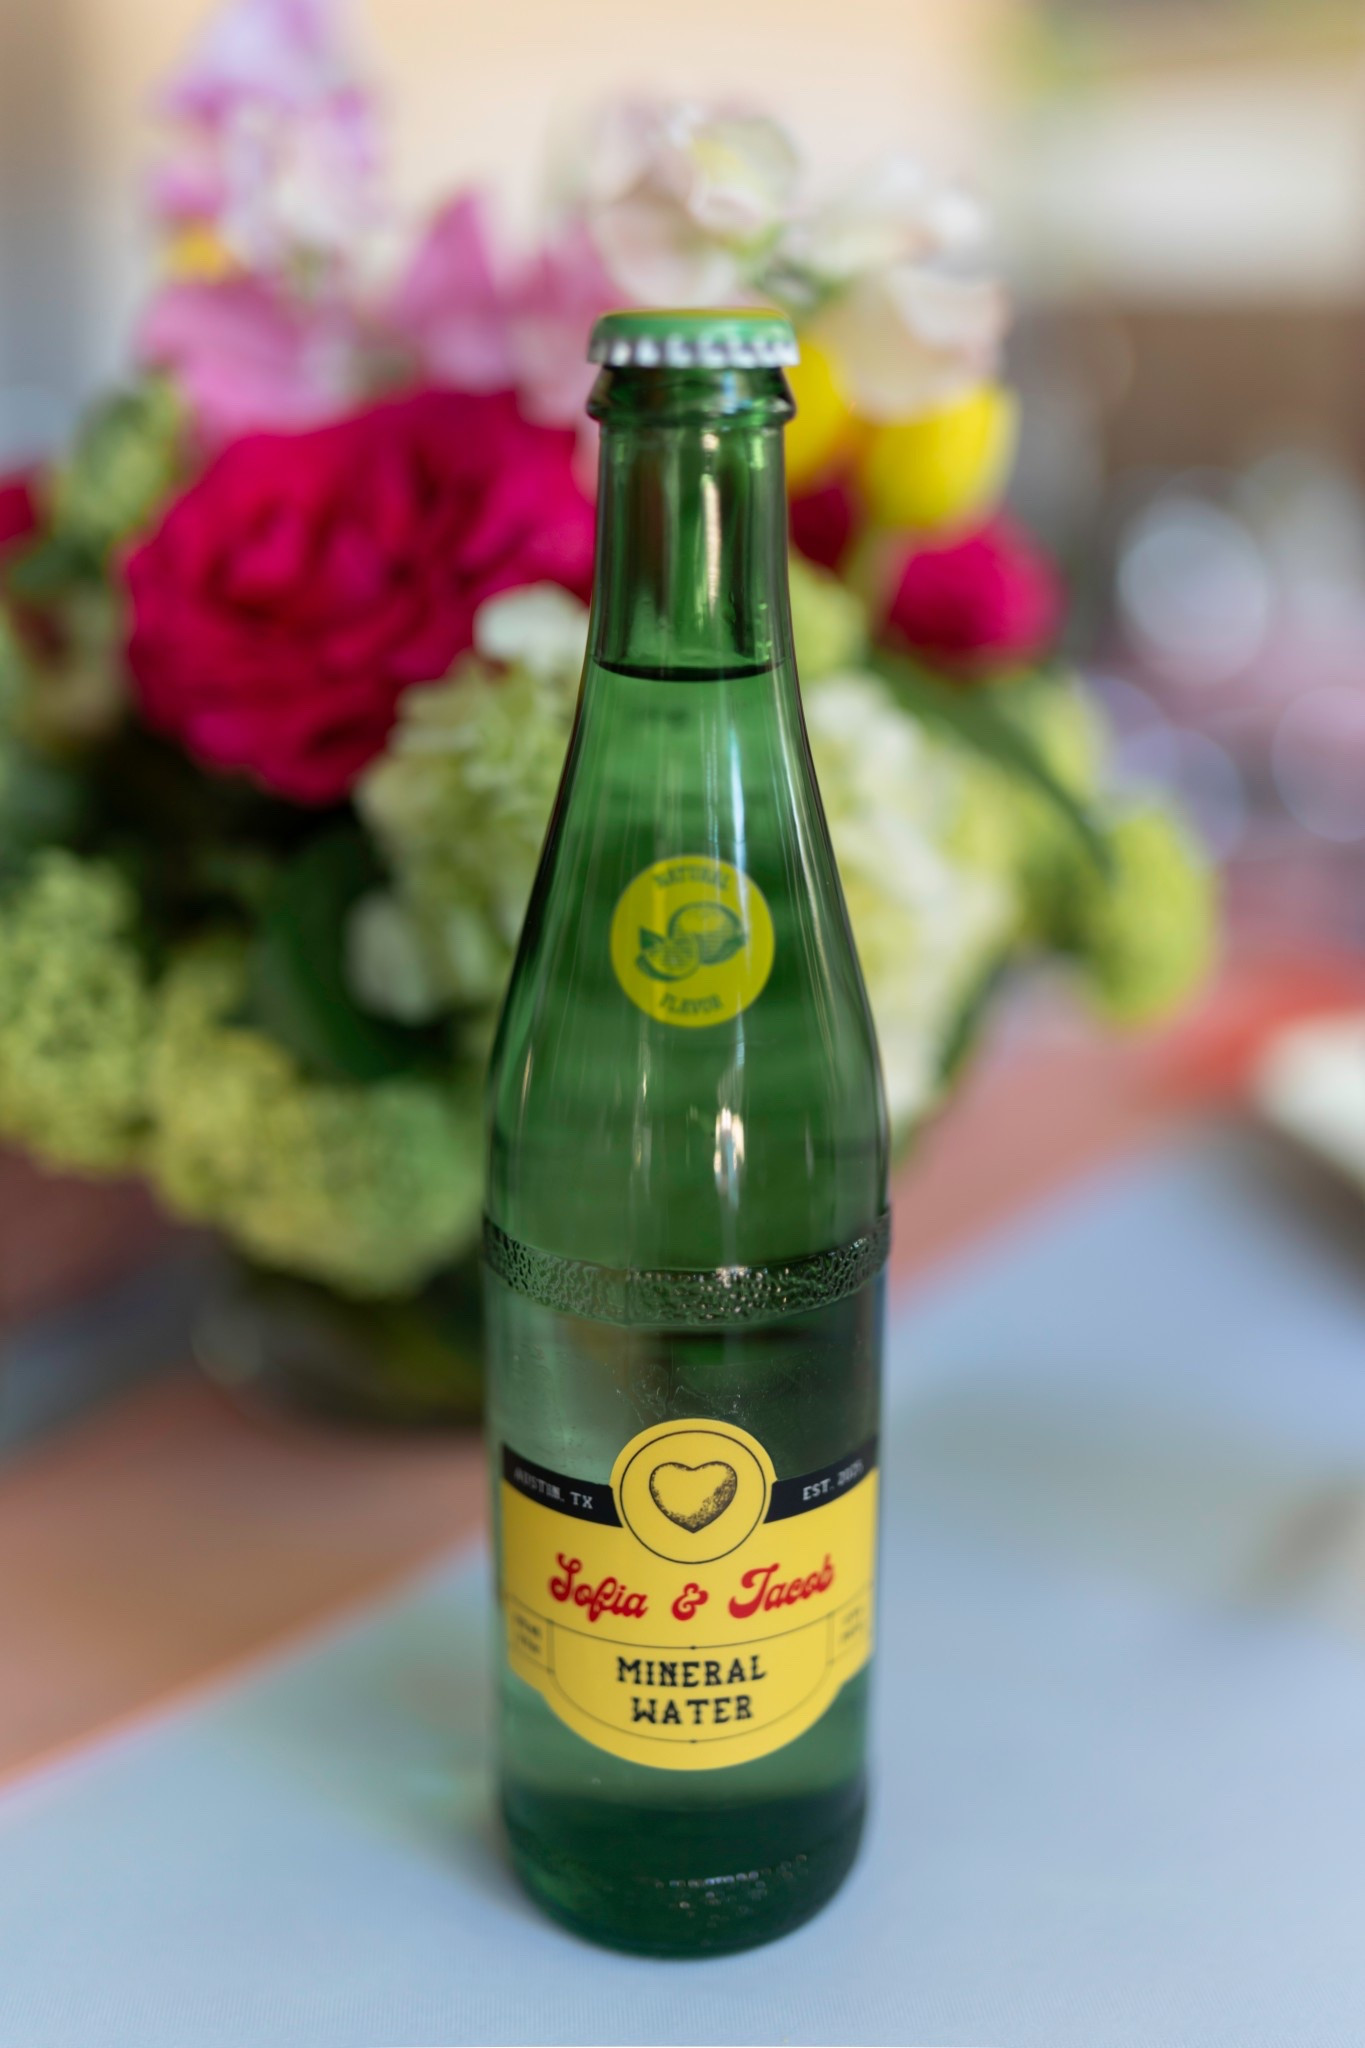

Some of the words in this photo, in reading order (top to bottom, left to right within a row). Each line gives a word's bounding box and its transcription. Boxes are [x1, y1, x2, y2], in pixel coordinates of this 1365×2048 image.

[570, 1491, 593, 1510] TX
[549, 1552, 648, 1622] Sofia
[671, 1582, 709, 1621] &
[728, 1553, 834, 1619] Jacob
[617, 1655, 766, 1688] MINERAL
[631, 1694, 752, 1725] WATER
